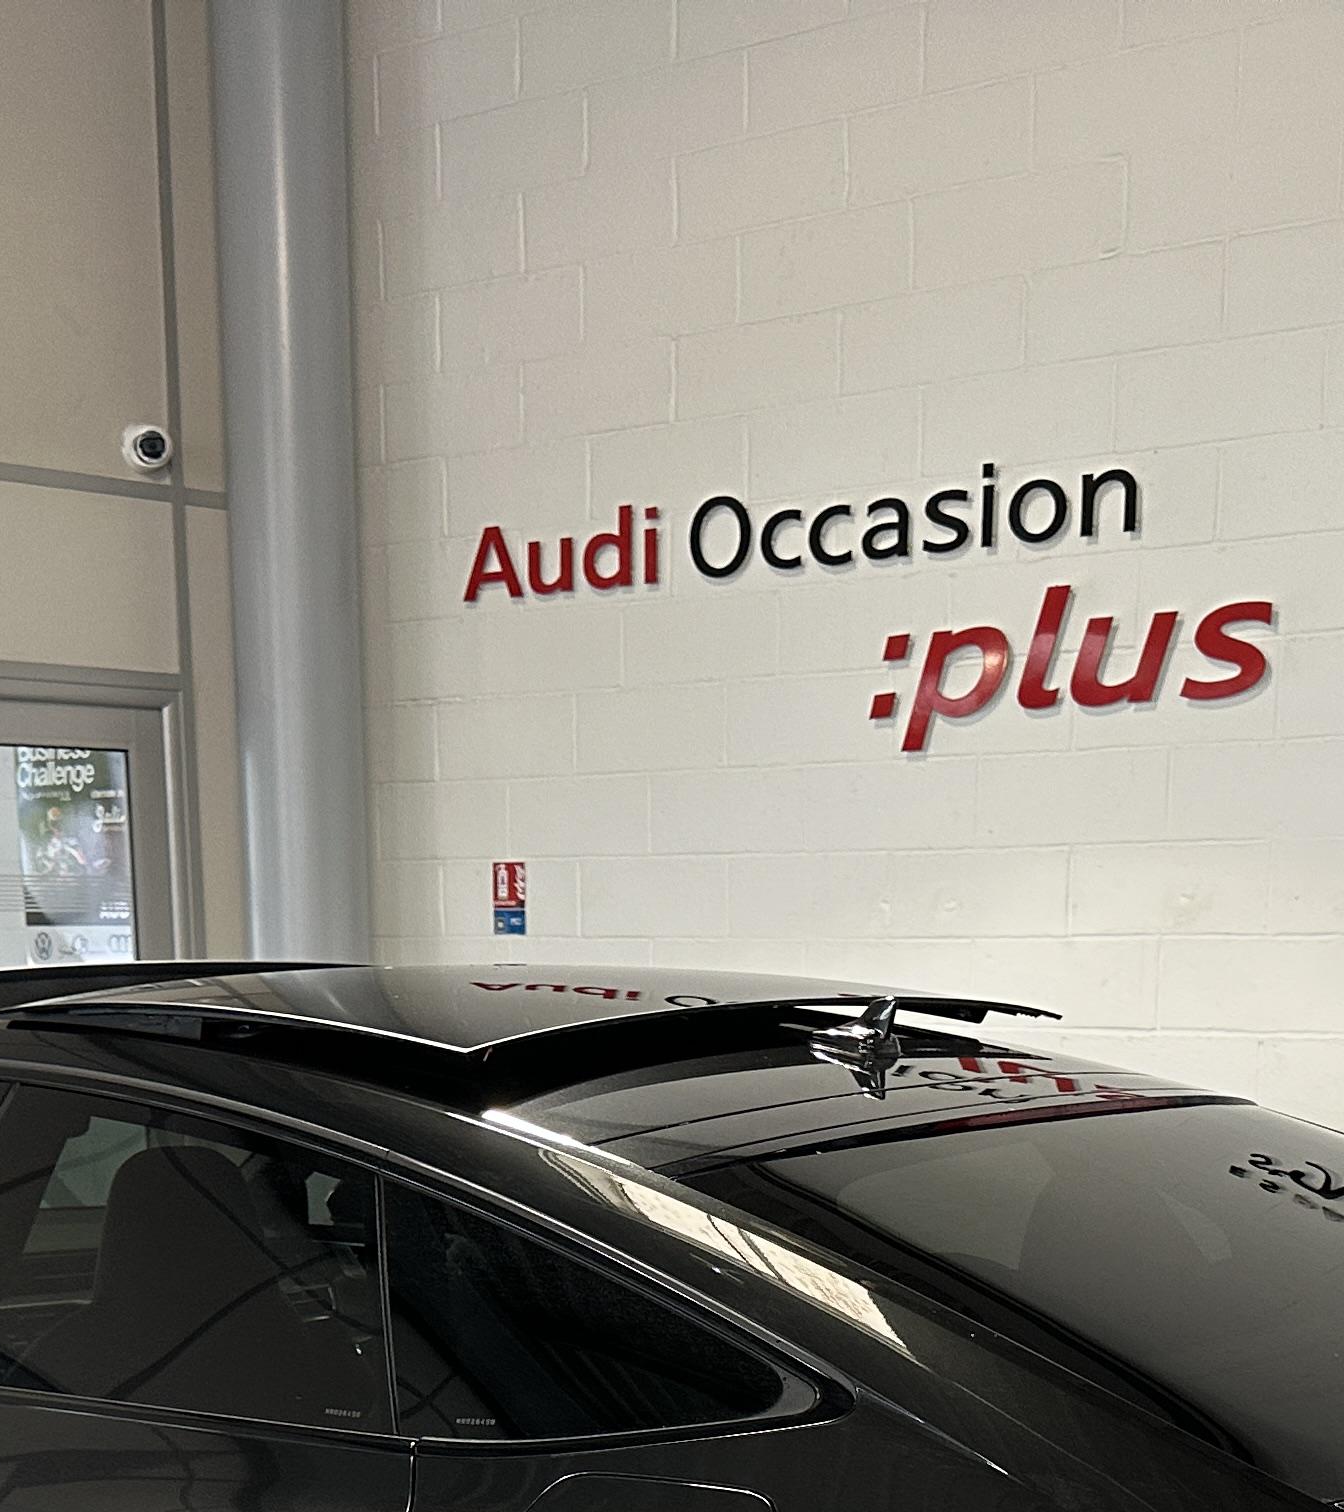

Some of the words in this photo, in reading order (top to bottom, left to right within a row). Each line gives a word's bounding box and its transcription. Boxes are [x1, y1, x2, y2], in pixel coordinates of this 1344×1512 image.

[463, 504, 661, 602] Audi
[689, 462, 1139, 580] Occasion
[869, 585, 1275, 752] :plus
[17, 762, 95, 791] Challenge
